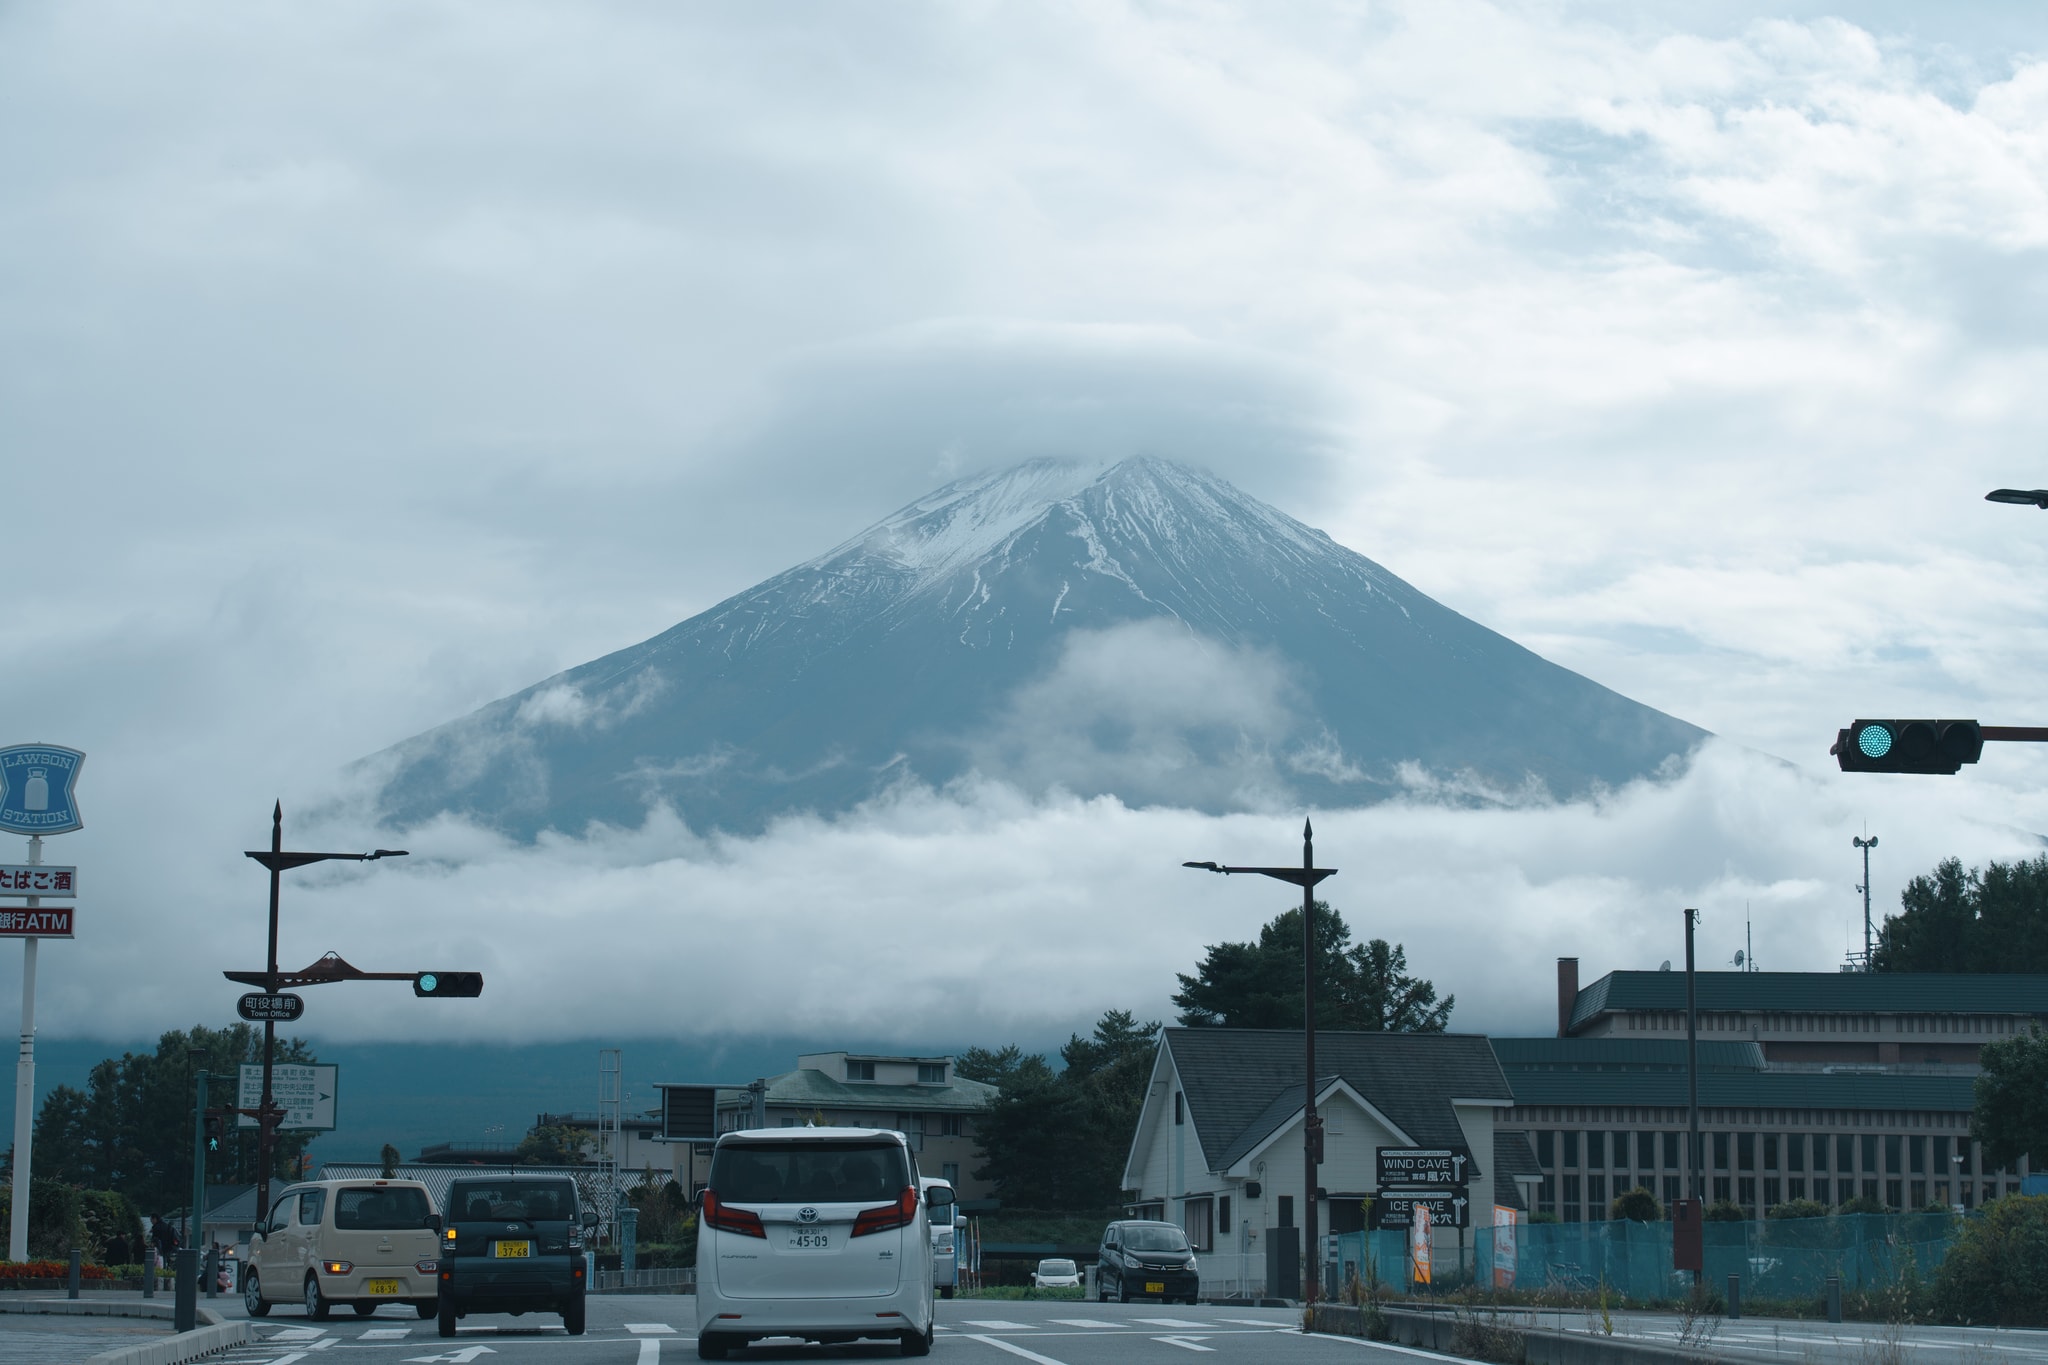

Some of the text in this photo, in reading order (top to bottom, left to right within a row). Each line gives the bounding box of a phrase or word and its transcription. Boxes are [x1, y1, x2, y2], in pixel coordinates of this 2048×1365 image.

[4, 754, 72, 769] LAWSON
[3, 809, 68, 824] STATION
[245, 997, 297, 1010] 町役場前
[270, 1010, 290, 1018] Office
[1383, 1159, 1414, 1169] WIND
[1417, 1159, 1450, 1169] CAVE
[1390, 1201, 1409, 1211] ICE
[797, 1236, 828, 1247] 45-09
[503, 1247, 528, 1257] 37-68
[375, 1285, 397, 1294] 68-36
